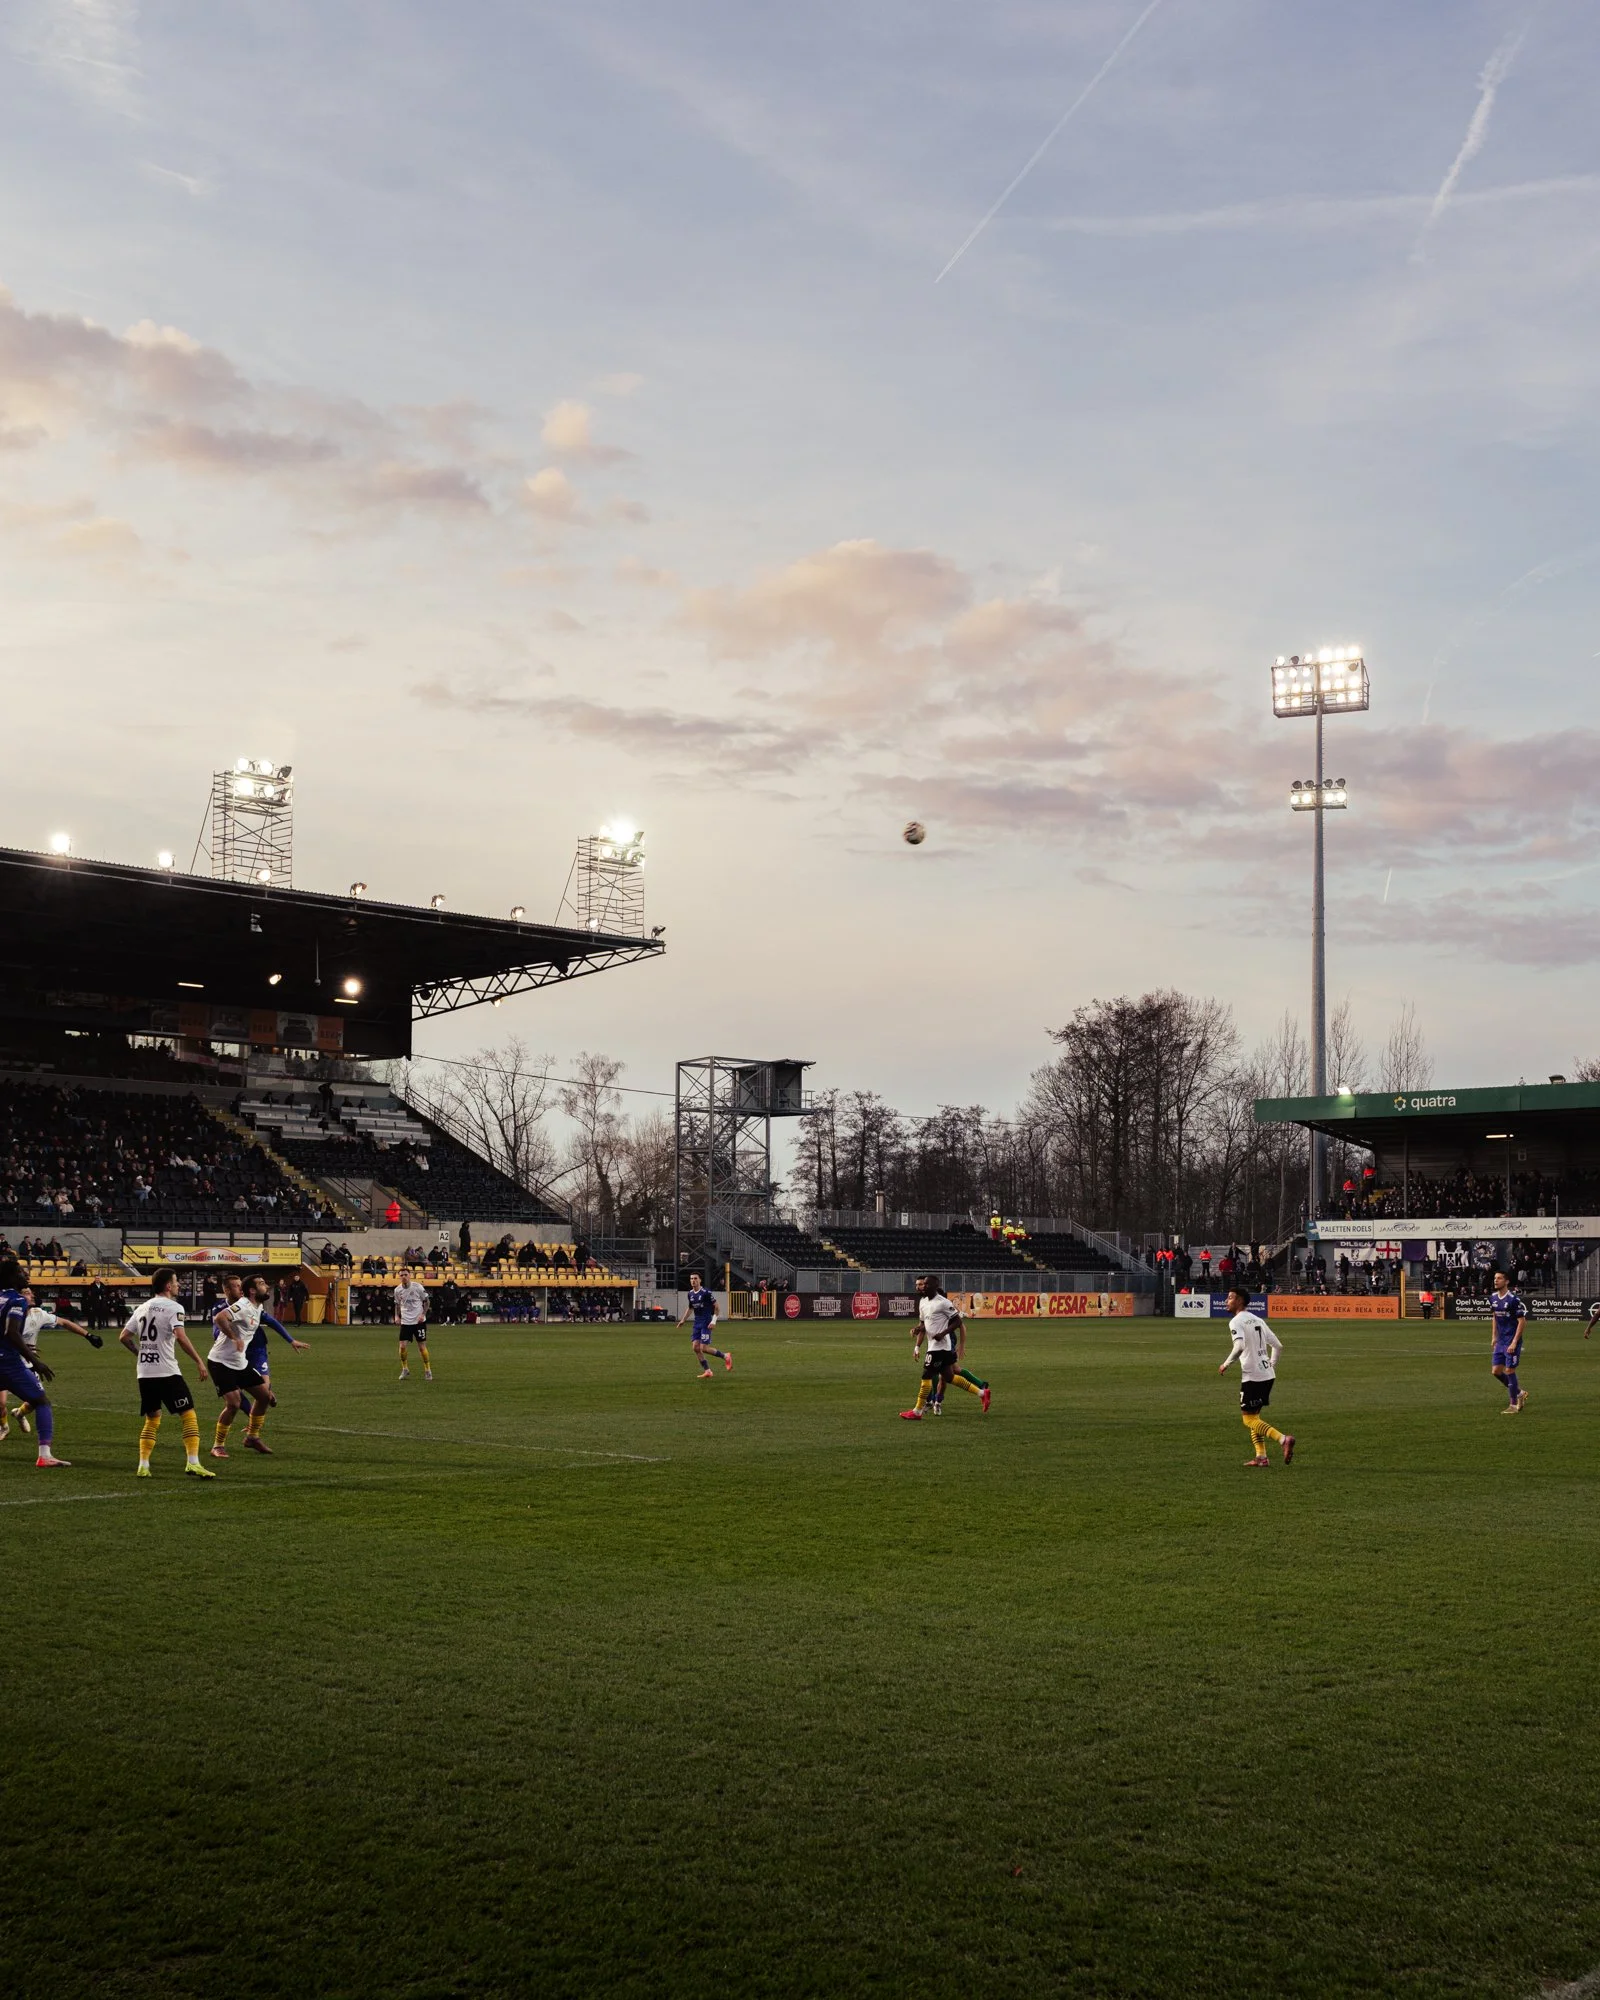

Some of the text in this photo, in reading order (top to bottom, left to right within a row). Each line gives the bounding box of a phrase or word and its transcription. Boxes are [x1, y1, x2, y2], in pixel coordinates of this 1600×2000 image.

[1411, 1095, 1456, 1111] quatra
[439, 1232, 449, 1241] A2
[995, 1295, 1036, 1315] CESAR
[1049, 1295, 1087, 1315] CESAR
[1531, 1299, 1548, 1307] Opel
[139, 1316, 158, 1342] 26
[417, 1328, 425, 1339] 25
[1255, 1326, 1262, 1349] 7
[140, 1352, 160, 1363] DSR
[1240, 1391, 1245, 1403] 7
